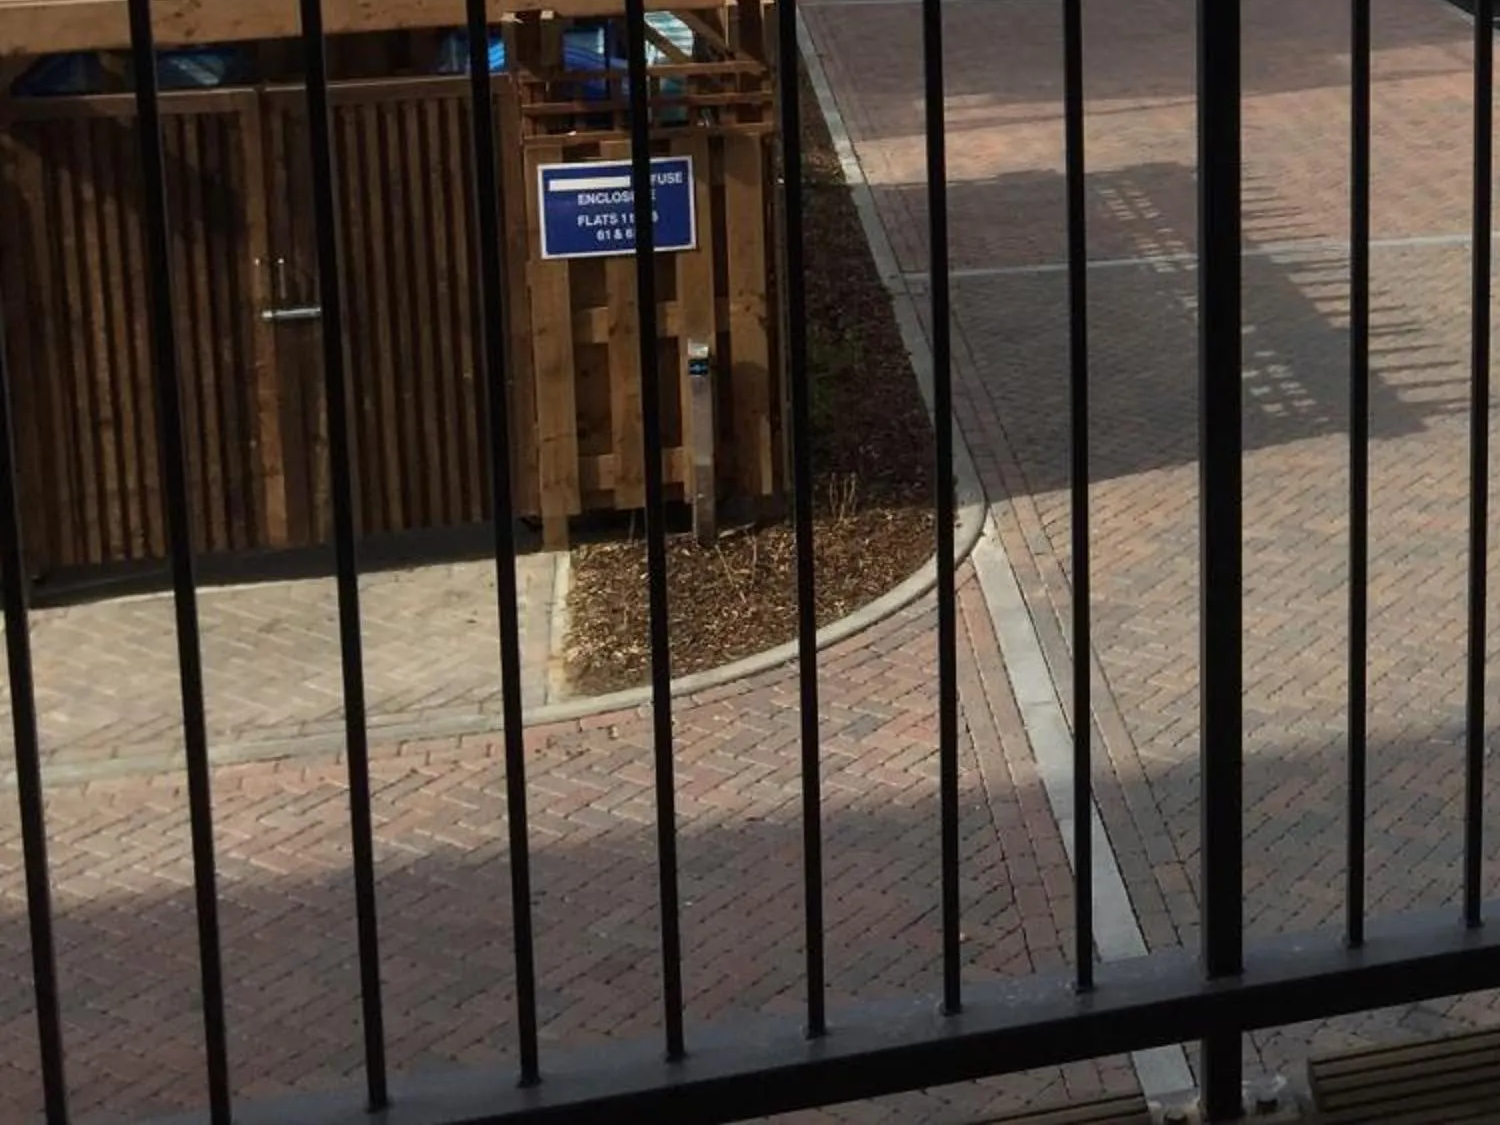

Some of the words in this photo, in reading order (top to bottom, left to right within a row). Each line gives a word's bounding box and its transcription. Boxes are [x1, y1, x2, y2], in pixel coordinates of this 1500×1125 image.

[647, 171, 683, 186] FUSE
[577, 189, 657, 206] ENCLOSE
[577, 213, 618, 227] FLATS
